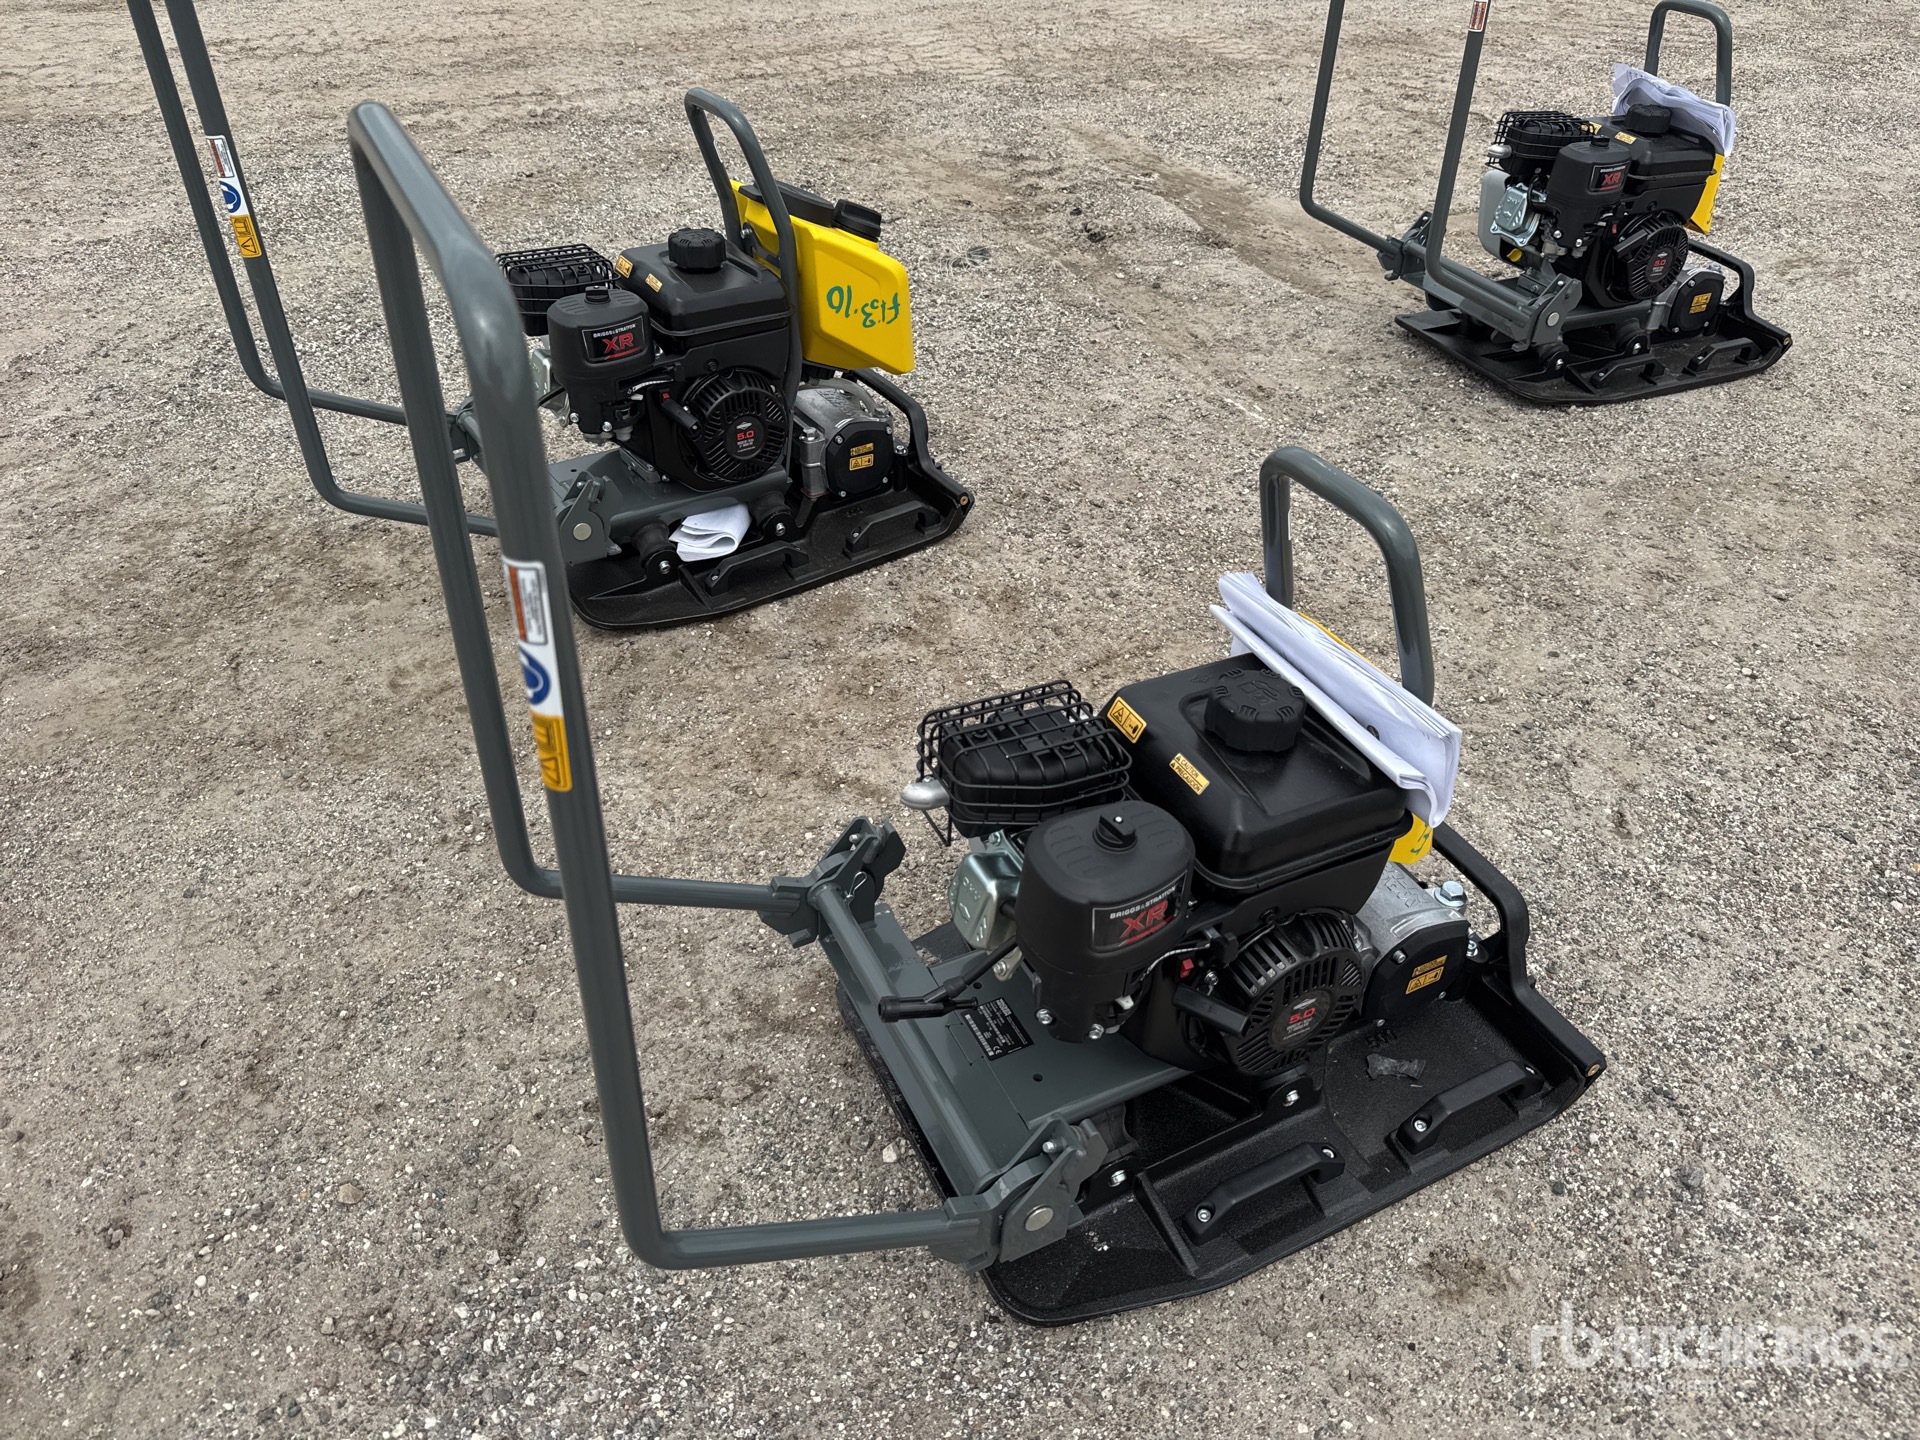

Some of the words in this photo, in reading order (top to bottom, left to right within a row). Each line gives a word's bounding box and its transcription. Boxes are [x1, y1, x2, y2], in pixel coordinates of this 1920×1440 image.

[602, 332, 634, 354] XR
[736, 430, 755, 441] 5.0
[1120, 899, 1169, 938] XR
[1288, 1007, 1317, 1024] 5.0
